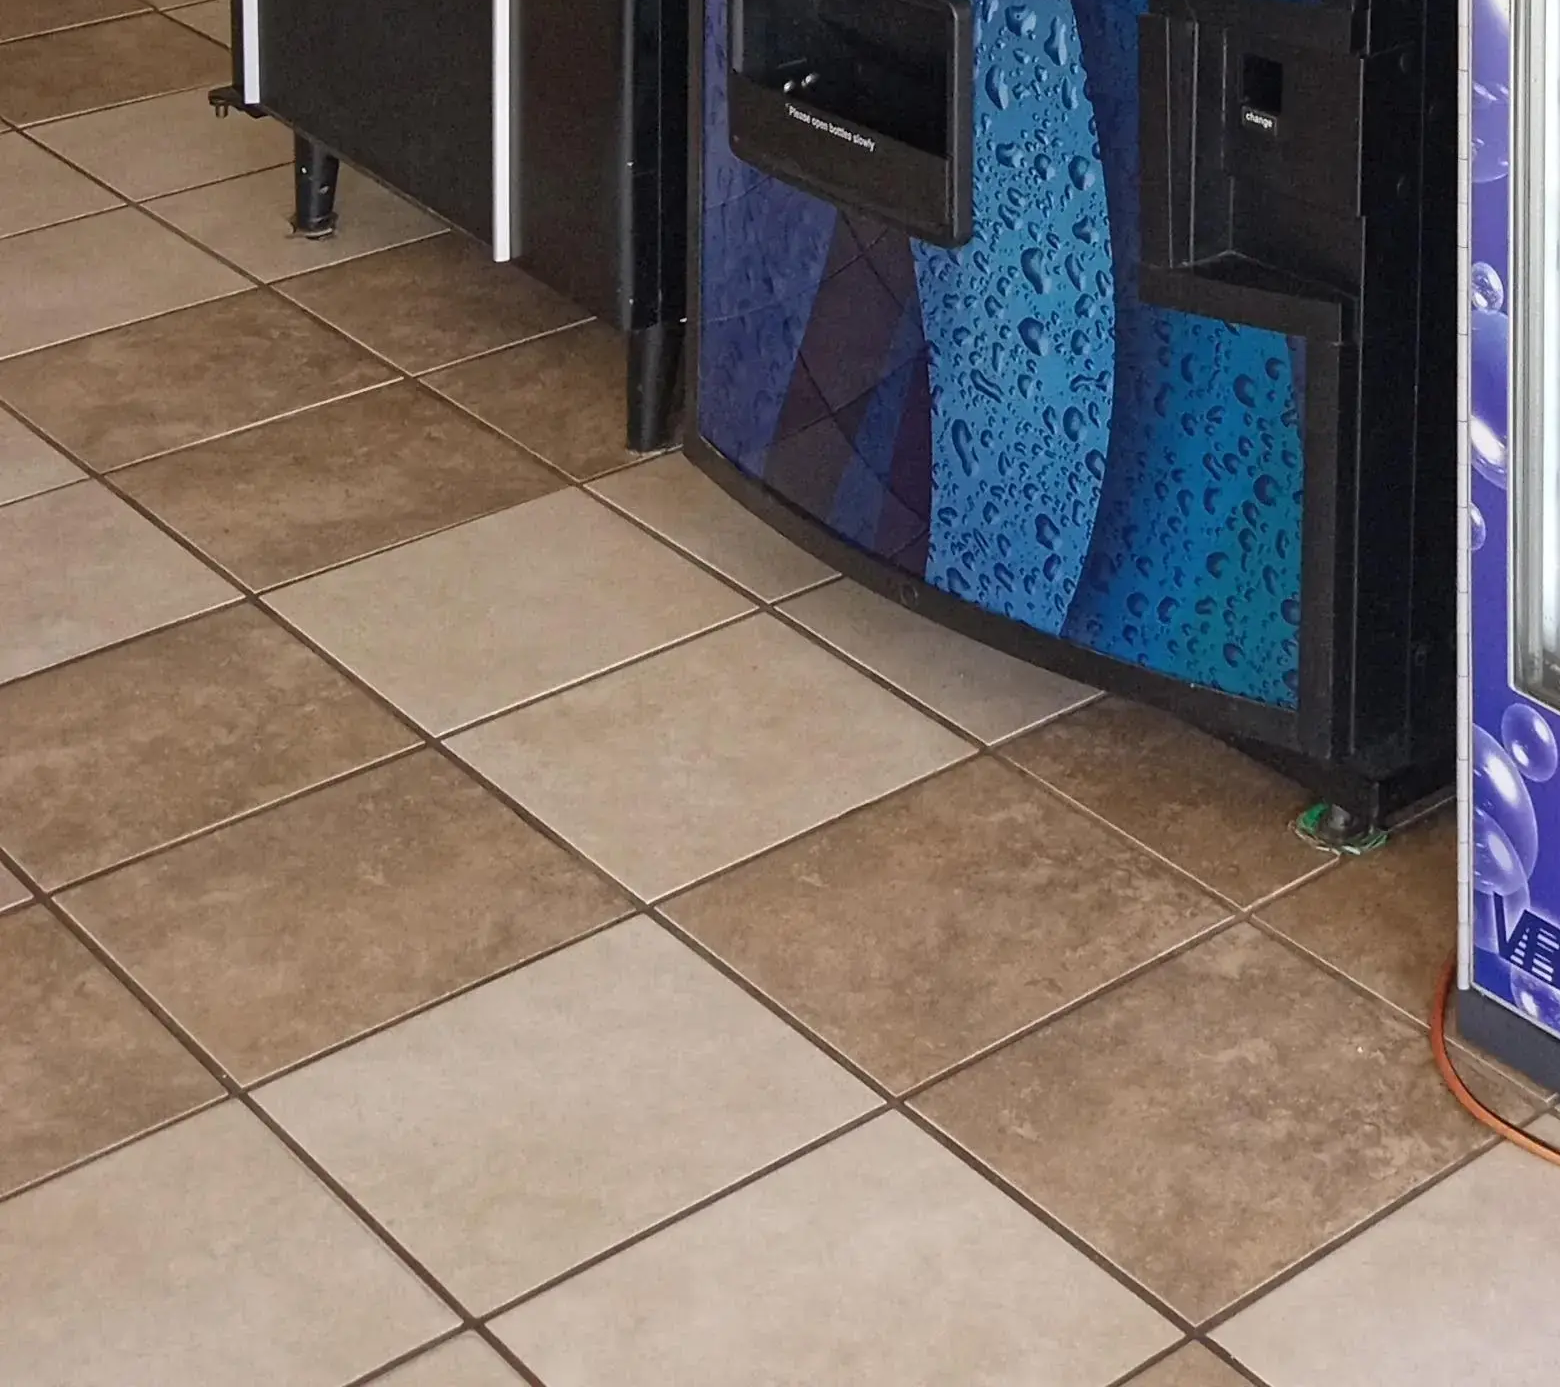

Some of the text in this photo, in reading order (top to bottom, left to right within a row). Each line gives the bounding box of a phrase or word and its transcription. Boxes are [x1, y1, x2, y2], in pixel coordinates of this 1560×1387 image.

[1245, 112, 1273, 129] change
[812, 117, 828, 131] open
[829, 123, 852, 141] bottles
[853, 134, 875, 152] slowly
